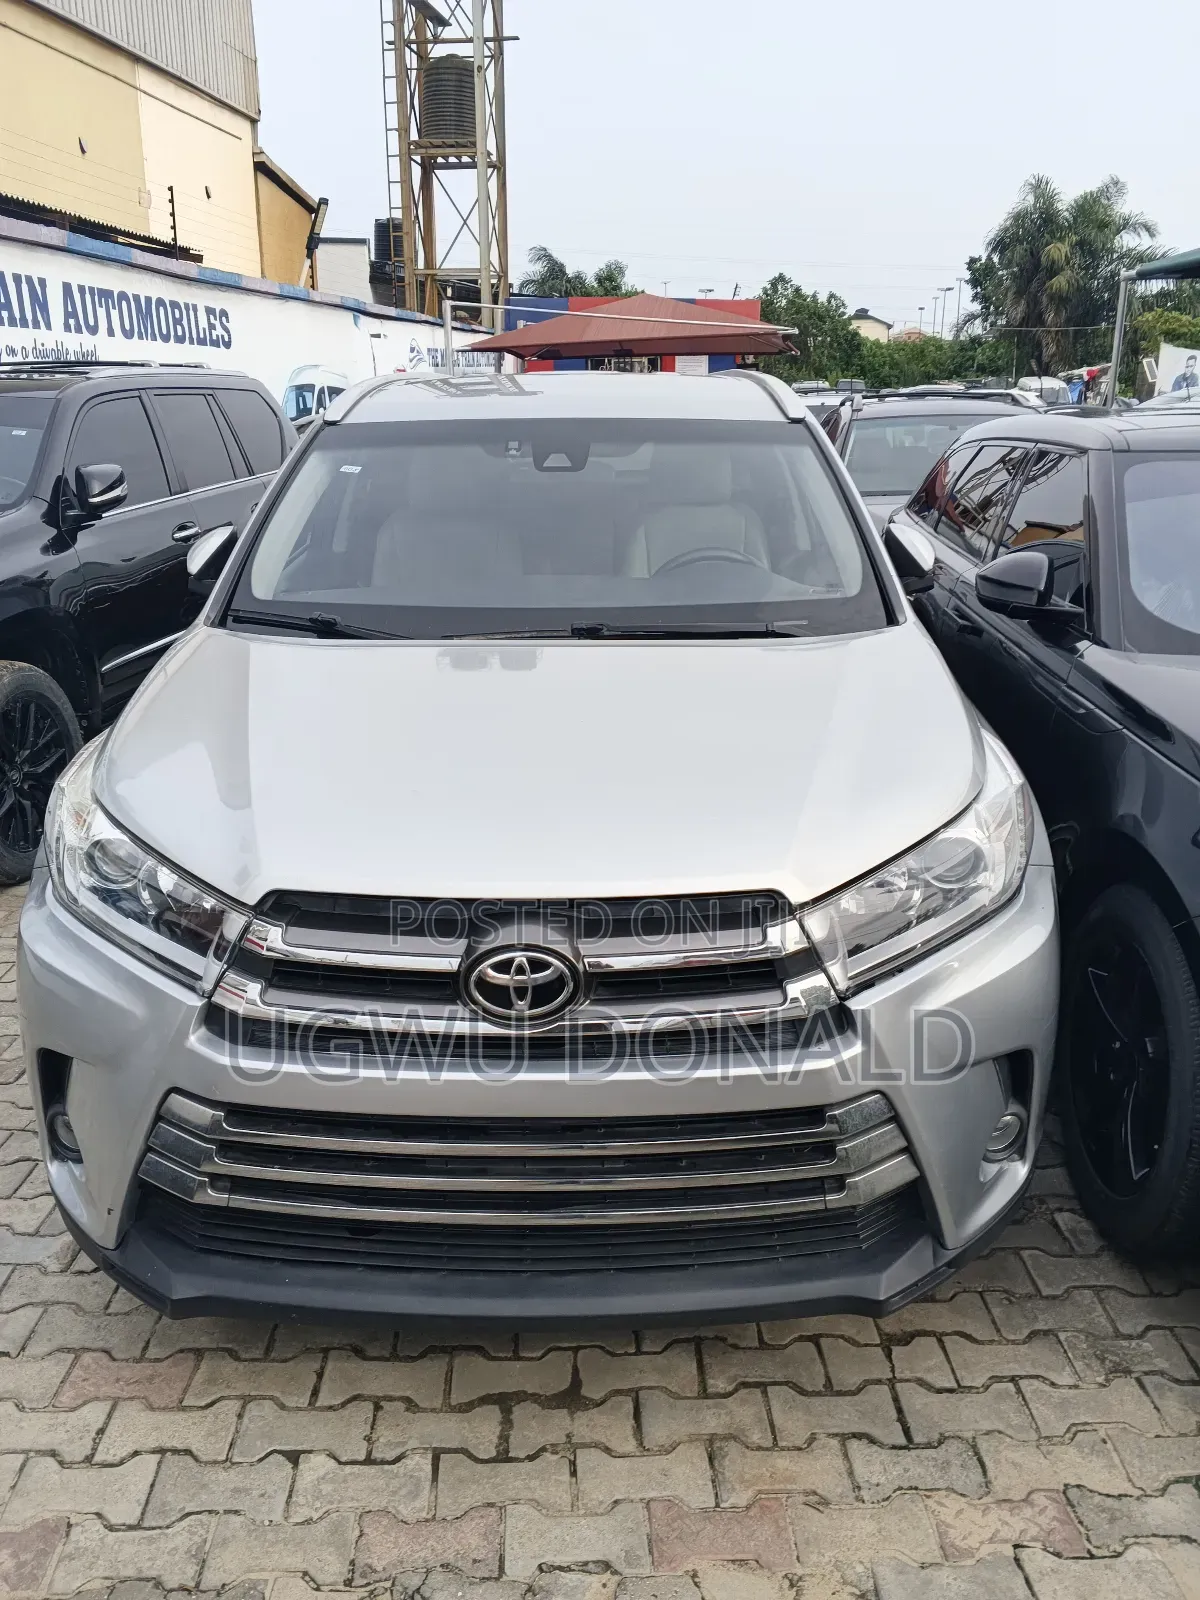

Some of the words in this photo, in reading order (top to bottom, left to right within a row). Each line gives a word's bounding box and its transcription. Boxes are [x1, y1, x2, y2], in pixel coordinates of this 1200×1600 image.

[62, 281, 232, 350] AUTOMOBILES
[6, 344, 18, 358] on
[21, 345, 29, 360] a
[32, 338, 71, 361] drivable
